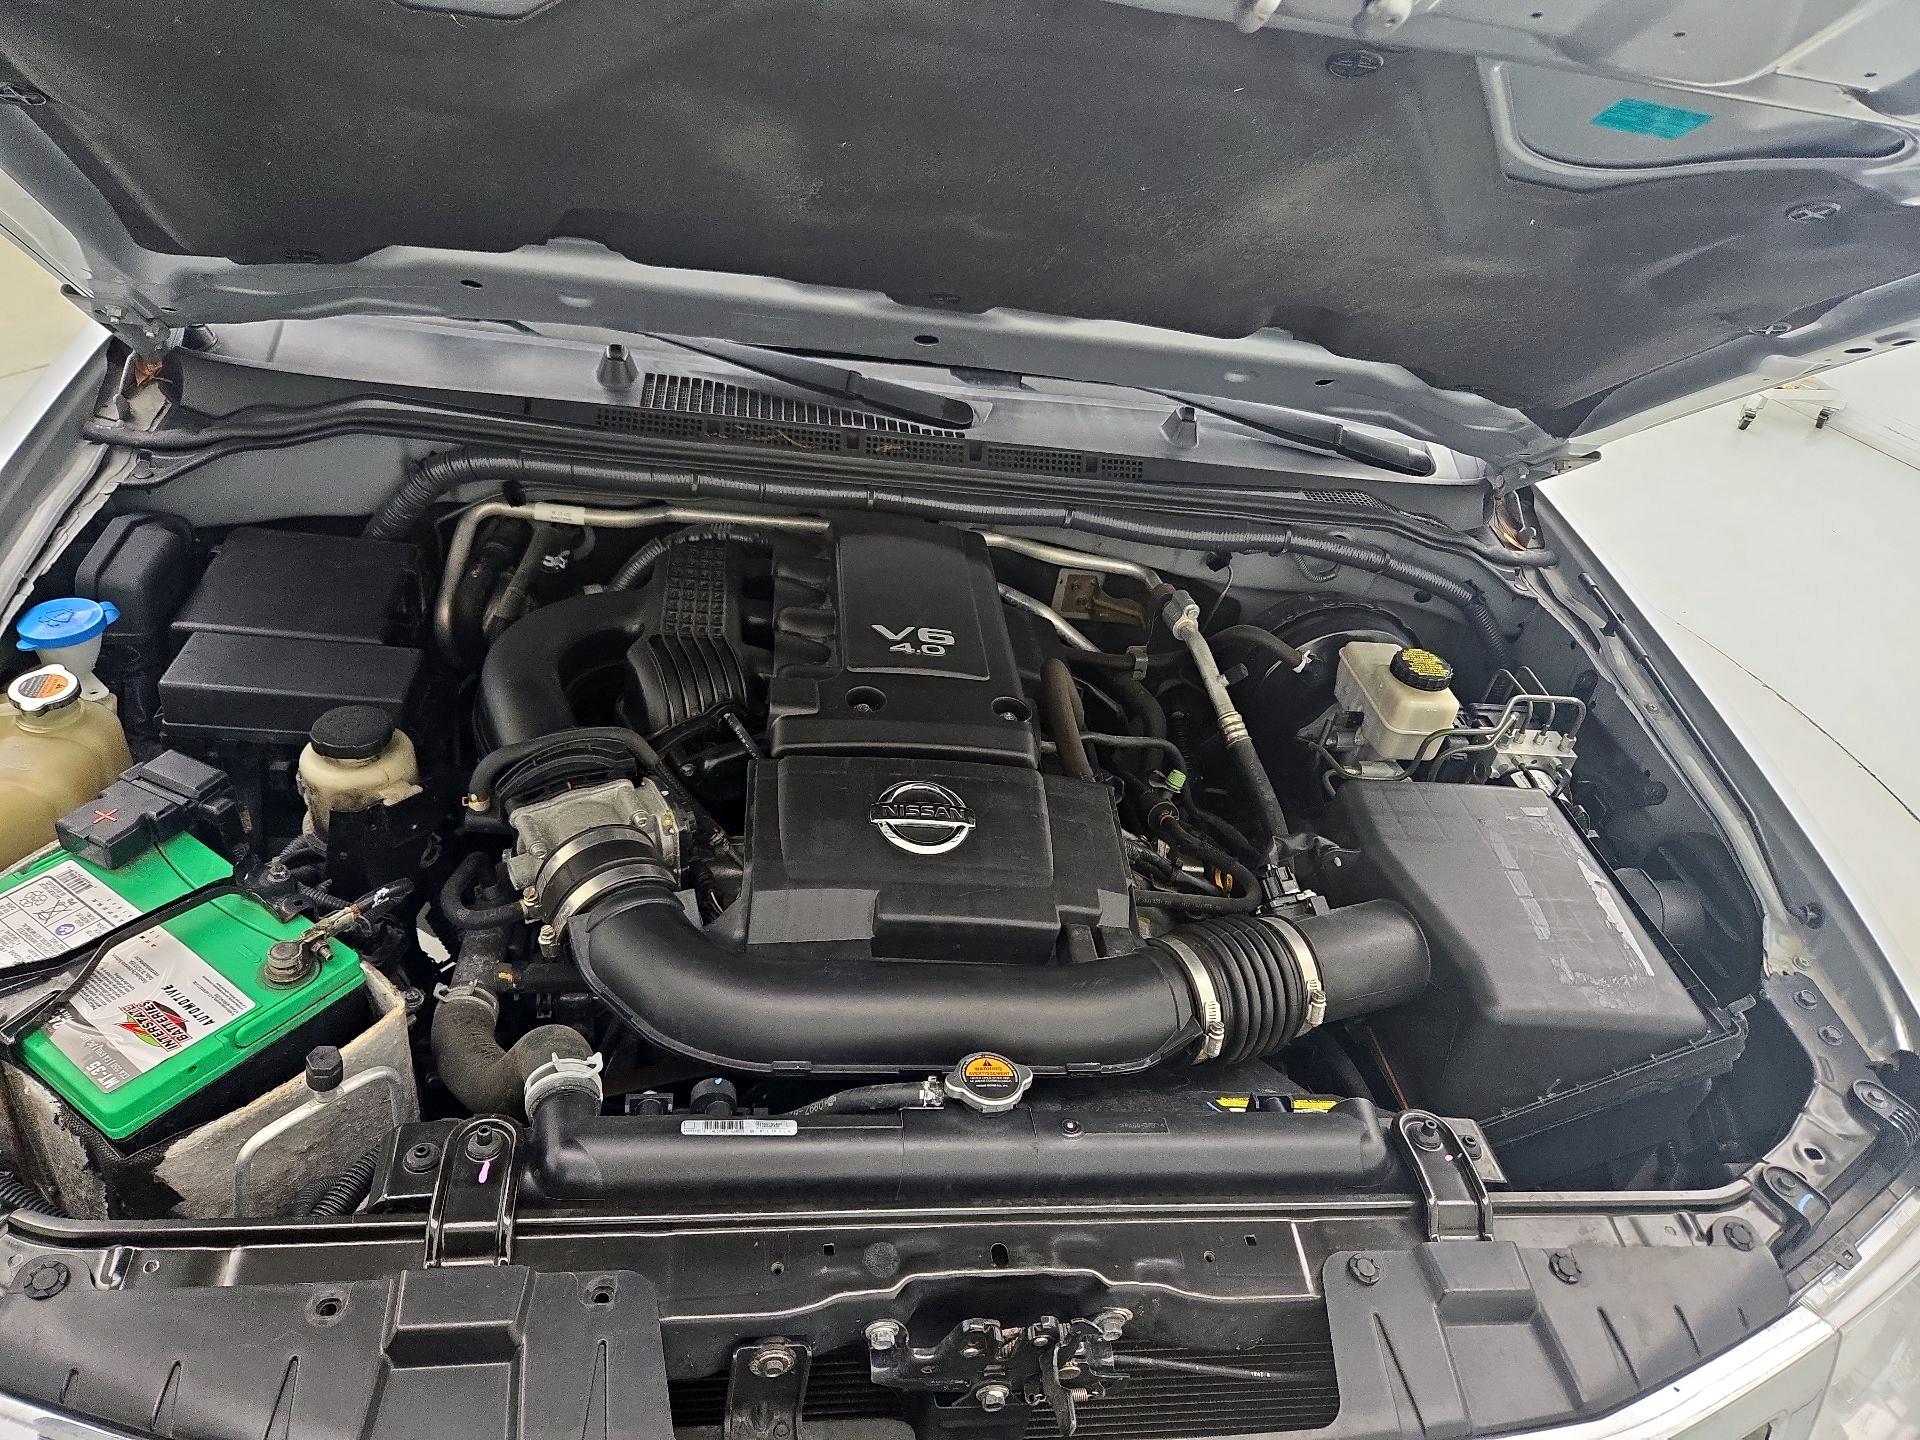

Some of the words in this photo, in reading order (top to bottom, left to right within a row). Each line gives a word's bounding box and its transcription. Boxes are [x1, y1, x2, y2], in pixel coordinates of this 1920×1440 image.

[871, 624, 955, 646] V6
[889, 642, 945, 656] 4.0
[882, 804, 965, 821] NISSAN
[161, 984, 215, 1026] AUTOMOTIVE
[120, 1003, 179, 1051] INTERSTATE
[139, 1000, 189, 1042] BATTERIES
[85, 1060, 120, 1089] MT-35
